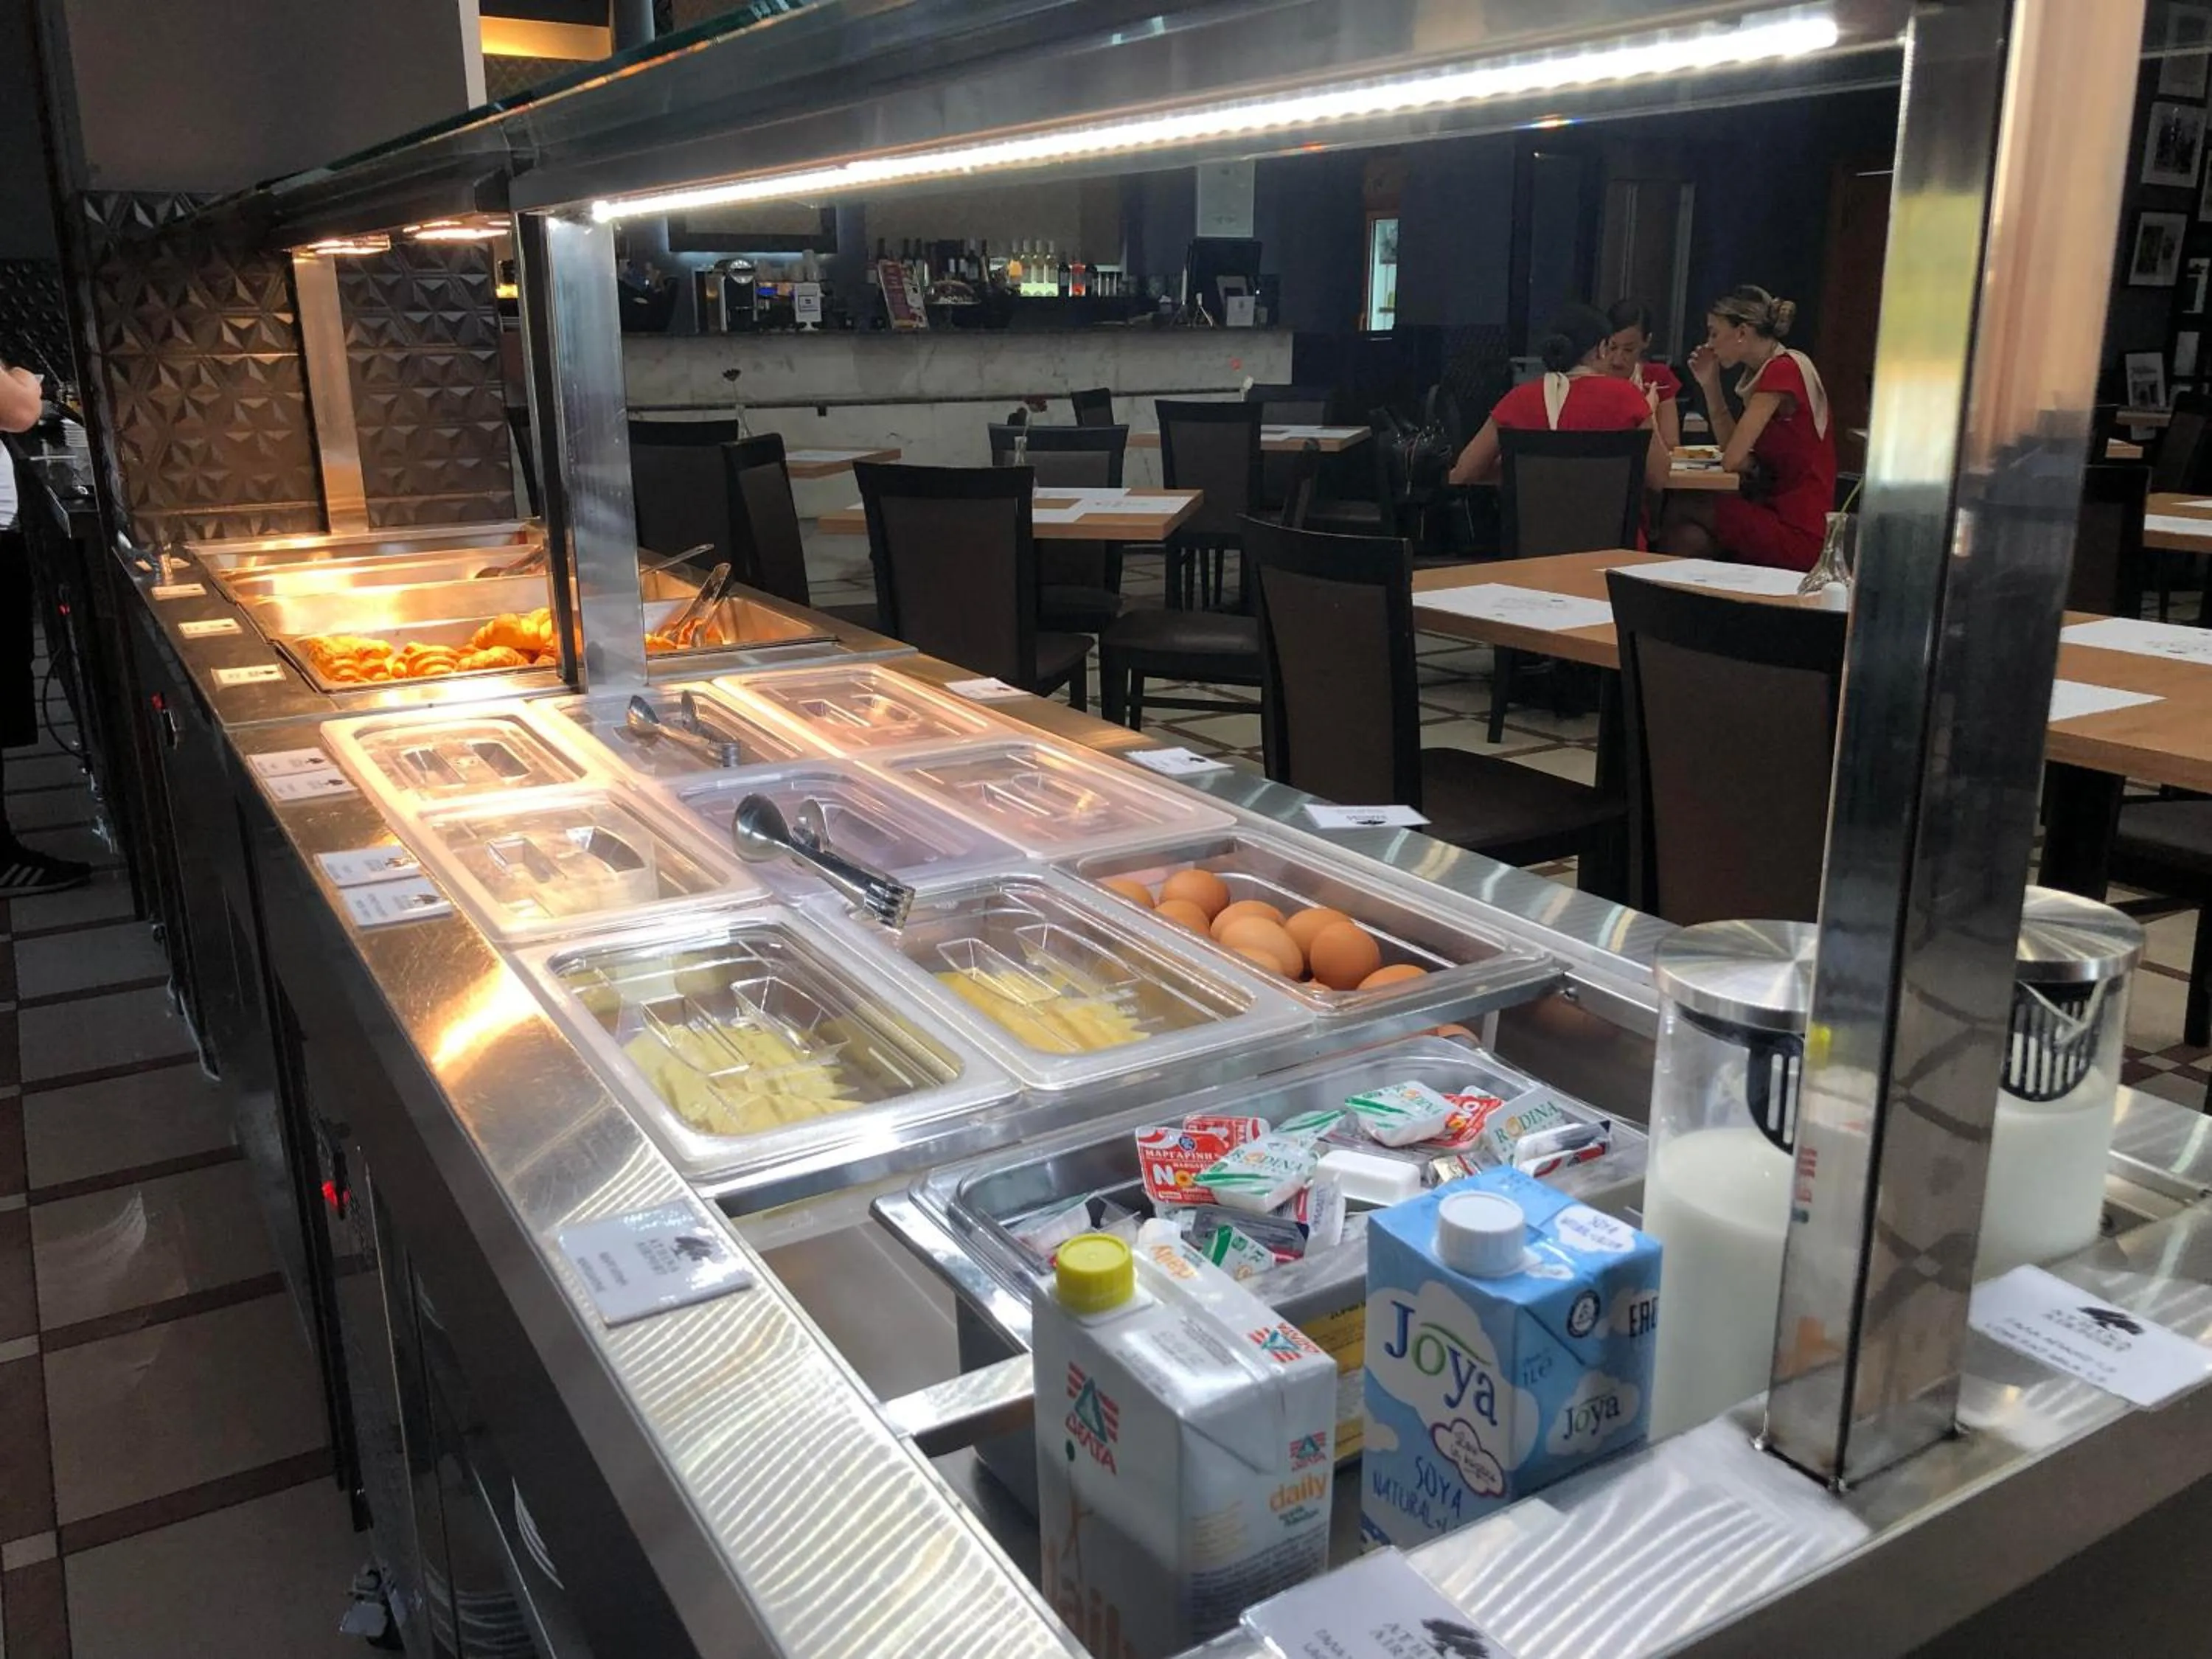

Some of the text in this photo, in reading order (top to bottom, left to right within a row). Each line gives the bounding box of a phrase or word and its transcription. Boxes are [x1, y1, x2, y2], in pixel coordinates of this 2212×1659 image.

[1494, 1100, 1559, 1144] RODINA
[1384, 1299, 1498, 1426] Joya
[1563, 1393, 1621, 1440] Joya
[1269, 1472, 1327, 1512] daily
[1372, 1470, 1436, 1530] NATURAL
[1415, 1455, 1464, 1518] SOYA
